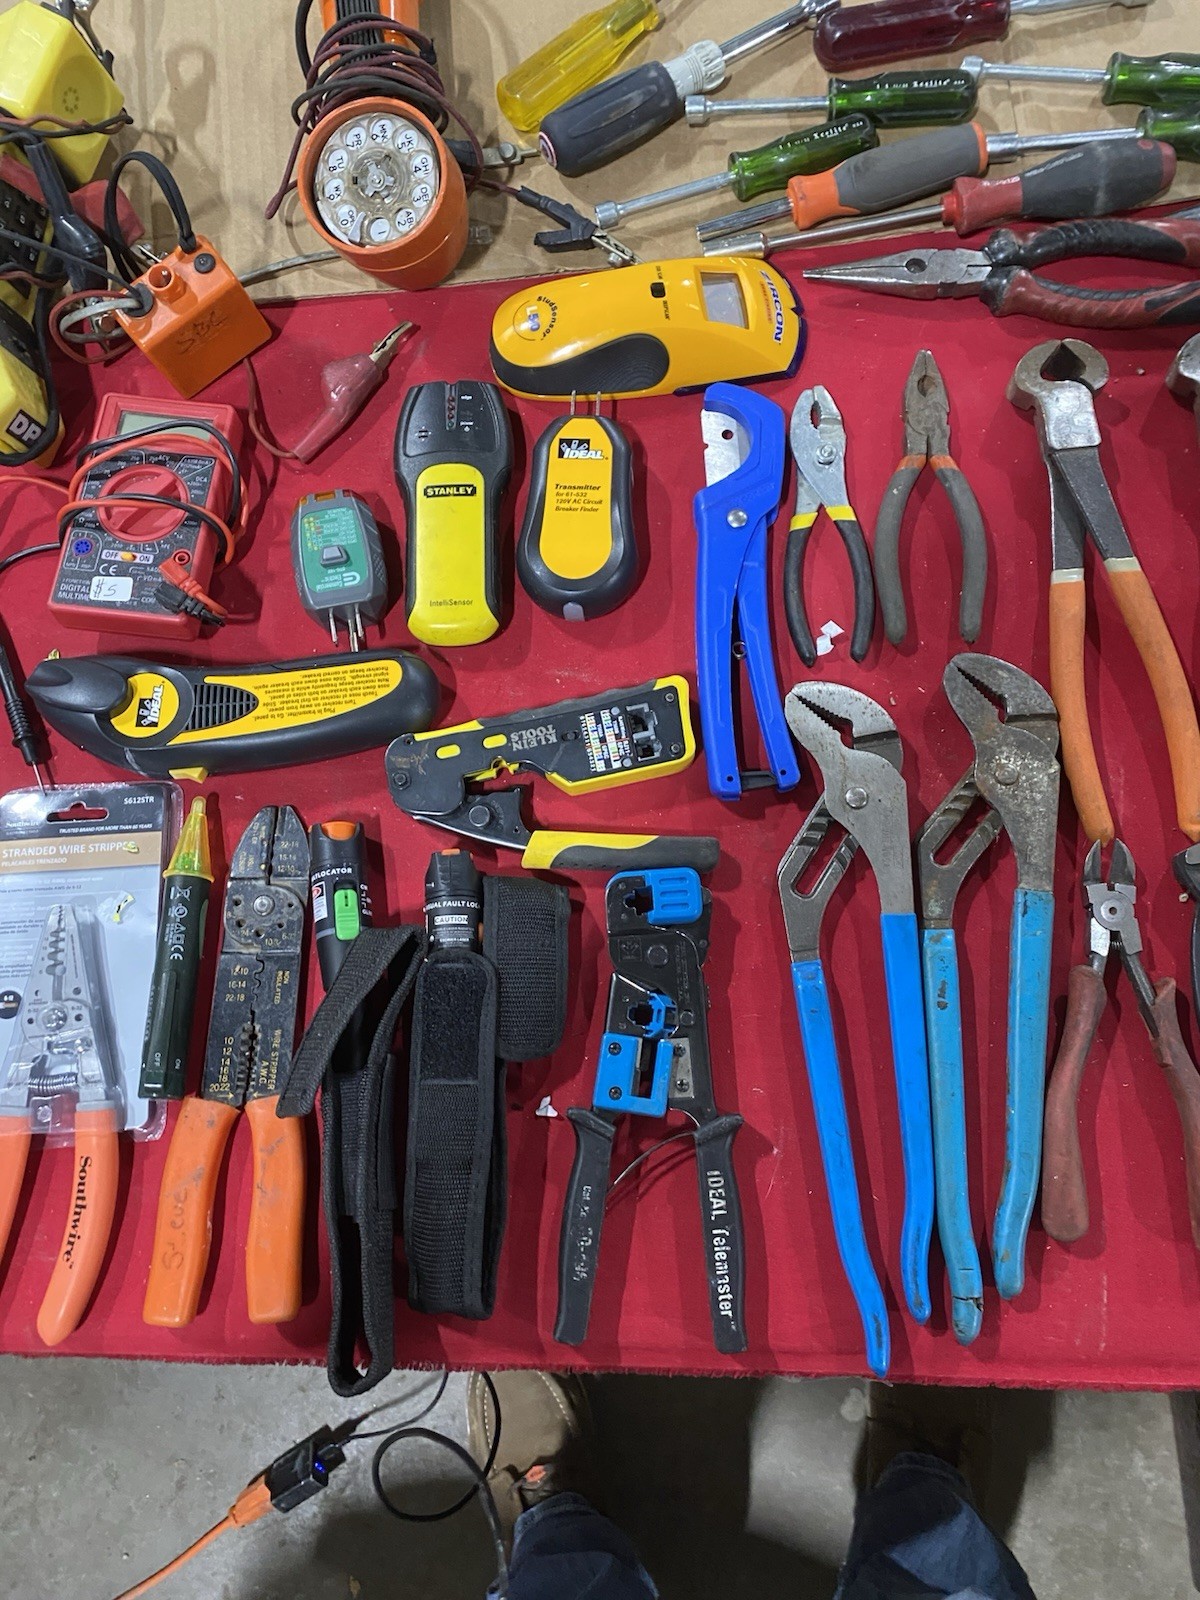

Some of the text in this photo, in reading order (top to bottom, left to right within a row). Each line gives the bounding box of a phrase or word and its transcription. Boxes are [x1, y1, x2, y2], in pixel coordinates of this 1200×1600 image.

[759, 269, 784, 343] ZIRCON
[536, 295, 558, 339] StudSensor
[562, 447, 604, 459] IDEAL
[426, 486, 474, 495] STANLEY
[104, 551, 119, 559] OFF
[60, 583, 90, 593] DIGITAL
[430, 598, 474, 607] IntelliSensor
[148, 684, 163, 726] IDEAL
[323, 706, 335, 714] Plug
[510, 724, 556, 741] TOOLS
[511, 733, 557, 751] KLEIN
[123, 795, 155, 805] S612STR
[2, 845, 57, 859] STRANDED
[59, 844, 86, 855] WIRE
[36, 857, 67, 866] TRENZADO
[442, 900, 465, 908] FAULT
[434, 913, 468, 925] CAUTION
[225, 994, 245, 1002] 22-18
[224, 1036, 234, 1045] 10
[223, 1047, 232, 1055] 12
[221, 1058, 230, 1066] 14
[267, 1029, 282, 1090] WIRE STRIPPER
[220, 1066, 229, 1075] 16
[219, 1074, 228, 1082] 18
[706, 1169, 728, 1221] IDEAL
[61, 1156, 93, 1264] Southwire
